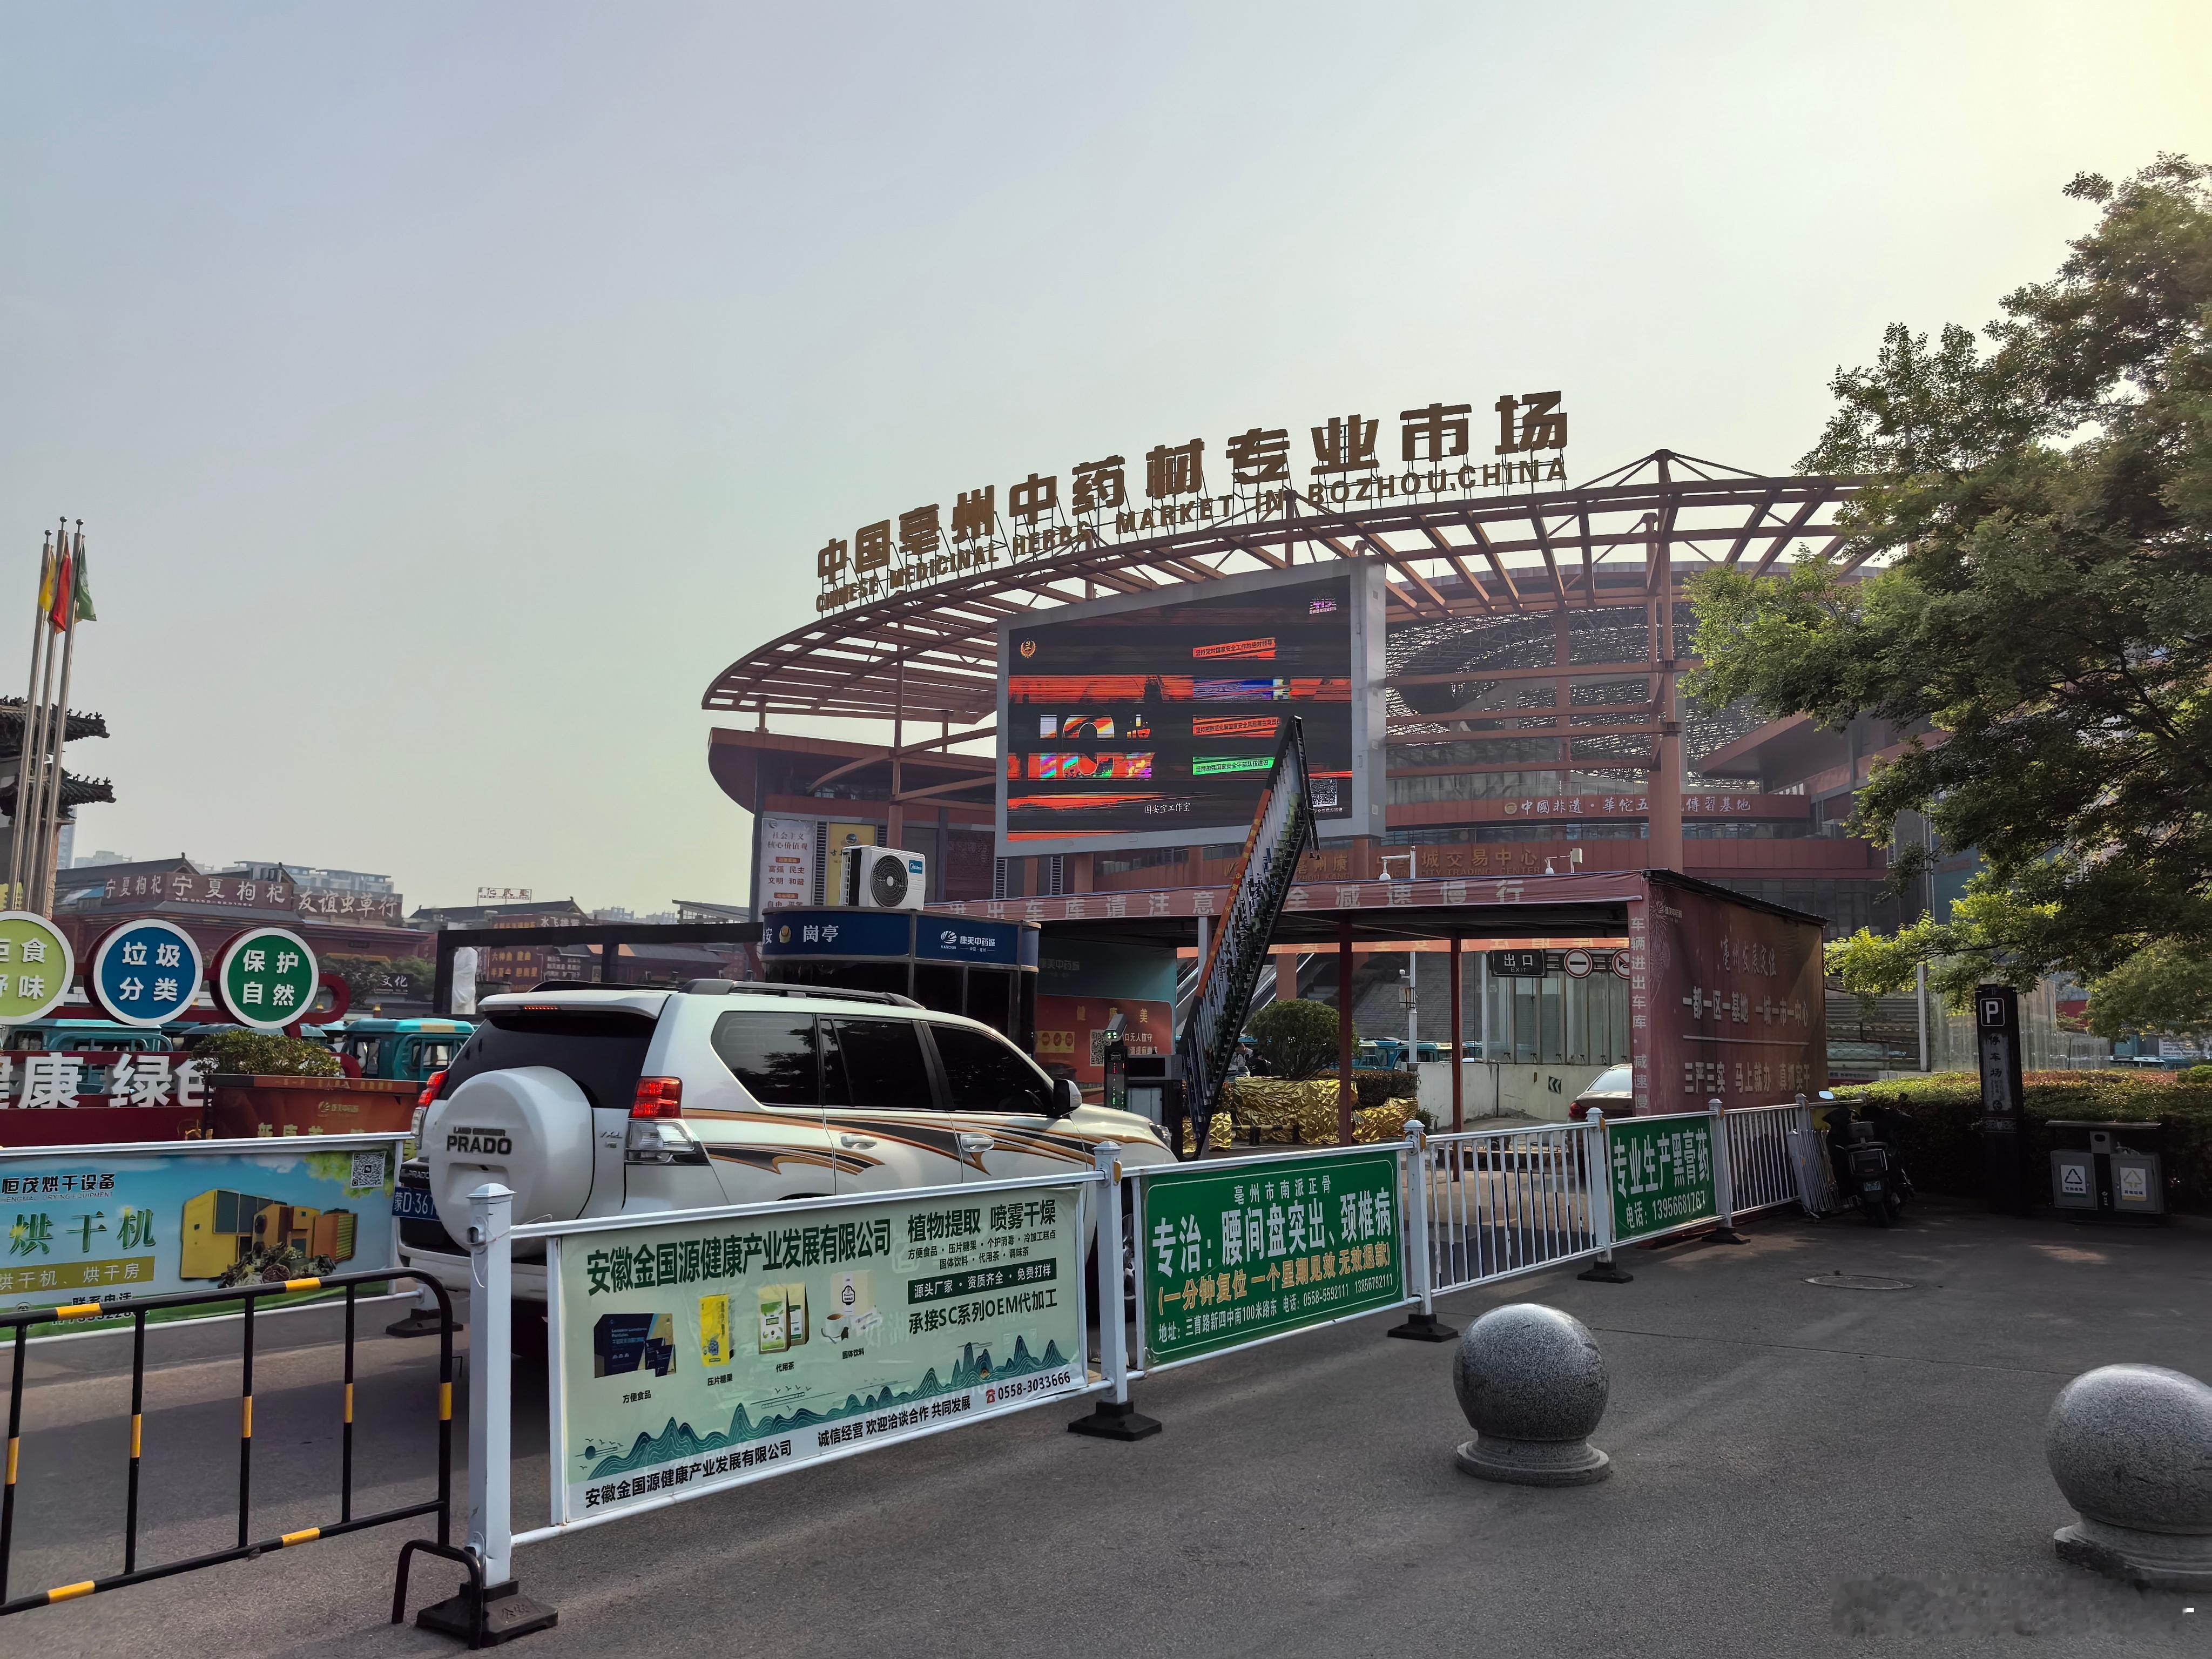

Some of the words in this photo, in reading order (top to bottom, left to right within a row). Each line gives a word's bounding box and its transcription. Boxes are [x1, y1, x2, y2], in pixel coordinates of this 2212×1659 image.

[818, 391, 1567, 584] 中国亳州中药材专业市场
[816, 576, 879, 612] CHINESE
[889, 543, 999, 589] MEDICINAL
[1013, 521, 1090, 557] HERBS
[1116, 495, 1233, 535] MARKET
[1256, 489, 1284, 514] IN
[767, 841, 808, 851] 核心价值观
[773, 832, 804, 840] 社会主义
[789, 866, 805, 874] 民主
[1447, 867, 1491, 875] TRADING
[1500, 866, 1540, 874] CENTER
[106, 875, 161, 899] 宁夏枸杞
[172, 875, 285, 903] 宁夏枸杞
[298, 887, 397, 918] 友谊虫草行
[122, 941, 180, 968] 垃圾
[960, 936, 995, 947] 康美中药城
[243, 949, 299, 974] 保护
[1504, 953, 1533, 967] 出口
[119, 977, 178, 1002] 分类
[242, 981, 295, 1007] 自然
[1683, 985, 1749, 1023] 一都一区一基地
[1986, 1001, 1999, 1024] P
[1988, 1035, 2002, 1078] 停车场
[0, 1051, 84, 1109] 康
[1684, 1061, 1725, 1094] 三严三实
[1735, 1062, 1771, 1093] 马上就办
[446, 1135, 512, 1155] PRADO
[1613, 1128, 1710, 1198] 专业生产黑膏药
[2, 1174, 115, 1195] 恒茂烘干设备
[1234, 1175, 1331, 1205] 亳州市南派正骨
[9, 1207, 156, 1256] 烘干机
[587, 1218, 891, 1296] 安徽金国源健康产业发展有限公司
[908, 1208, 981, 1243] 植物提取
[990, 1199, 1056, 1232] 喷雾干燥
[908, 1245, 938, 1260] 方便食品
[948, 1240, 977, 1254] 压片糖果
[987, 1235, 1014, 1249] 个护消毒
[1024, 1230, 1056, 1243] 冷加工糕点
[940, 1255, 968, 1270] 固体饮料
[979, 1251, 999, 1264] 代用茶
[1009, 1246, 1029, 1259] 调味茶
[914, 1276, 953, 1298] 源头厂家
[967, 1269, 1003, 1289] 资质齐全
[1017, 1263, 1051, 1282] 免费打样
[1251, 1252, 1336, 1292] 一个星期见效
[1355, 1272, 1393, 1293] 13856792111
[908, 1289, 1057, 1336] 承接SC系列OEM代加工
[842, 1347, 864, 1359] 固体饮料
[707, 1373, 733, 1386] 压片糖果
[776, 1361, 794, 1372] 代用茶
[623, 1390, 651, 1404] 方便食品
[586, 1439, 792, 1508] 安徽金国源健康产业发展有限公司
[818, 1421, 864, 1447] 诚信经营
[866, 1405, 929, 1435] 欢迎洽谈合作
[932, 1395, 970, 1418] 共同发展
[997, 1372, 1070, 1400] 0558-3033666
